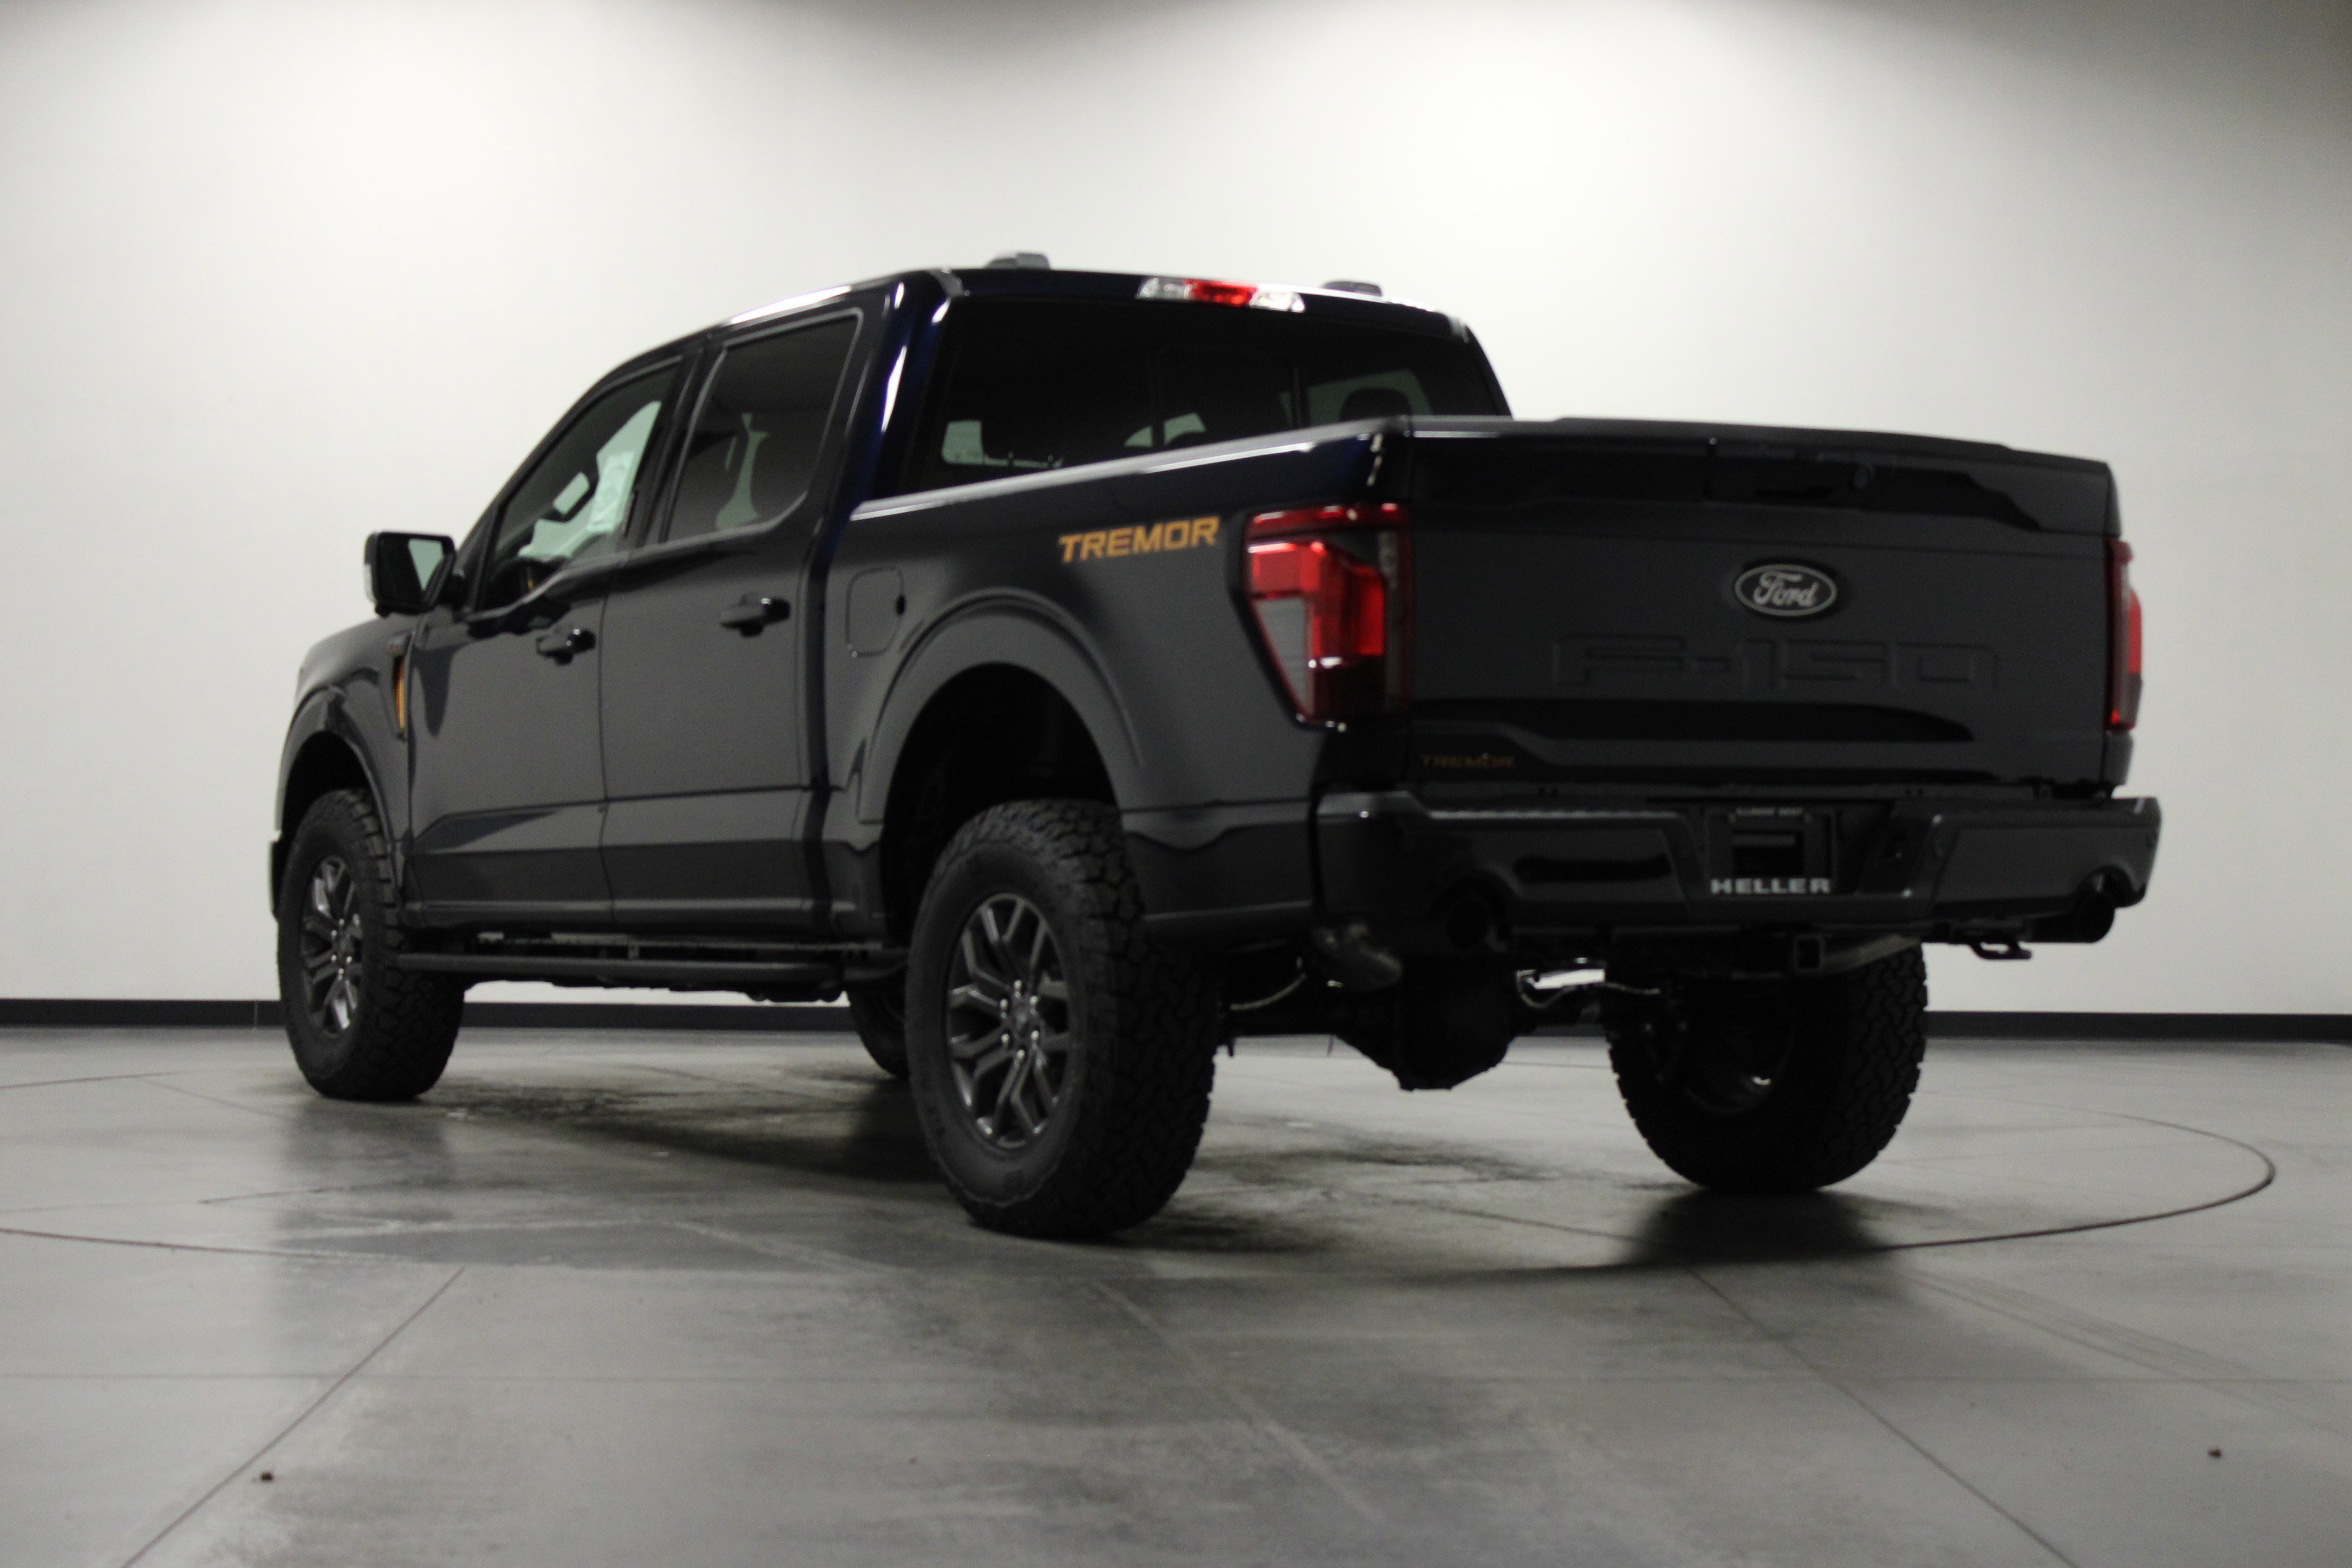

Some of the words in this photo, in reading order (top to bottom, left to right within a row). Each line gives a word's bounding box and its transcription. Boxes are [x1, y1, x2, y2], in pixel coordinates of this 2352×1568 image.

[1059, 515, 1221, 562] TREMOR
[1753, 570, 1820, 607] Ford
[1552, 632, 2000, 695] F-150
[1710, 877, 1830, 894] HELLER
